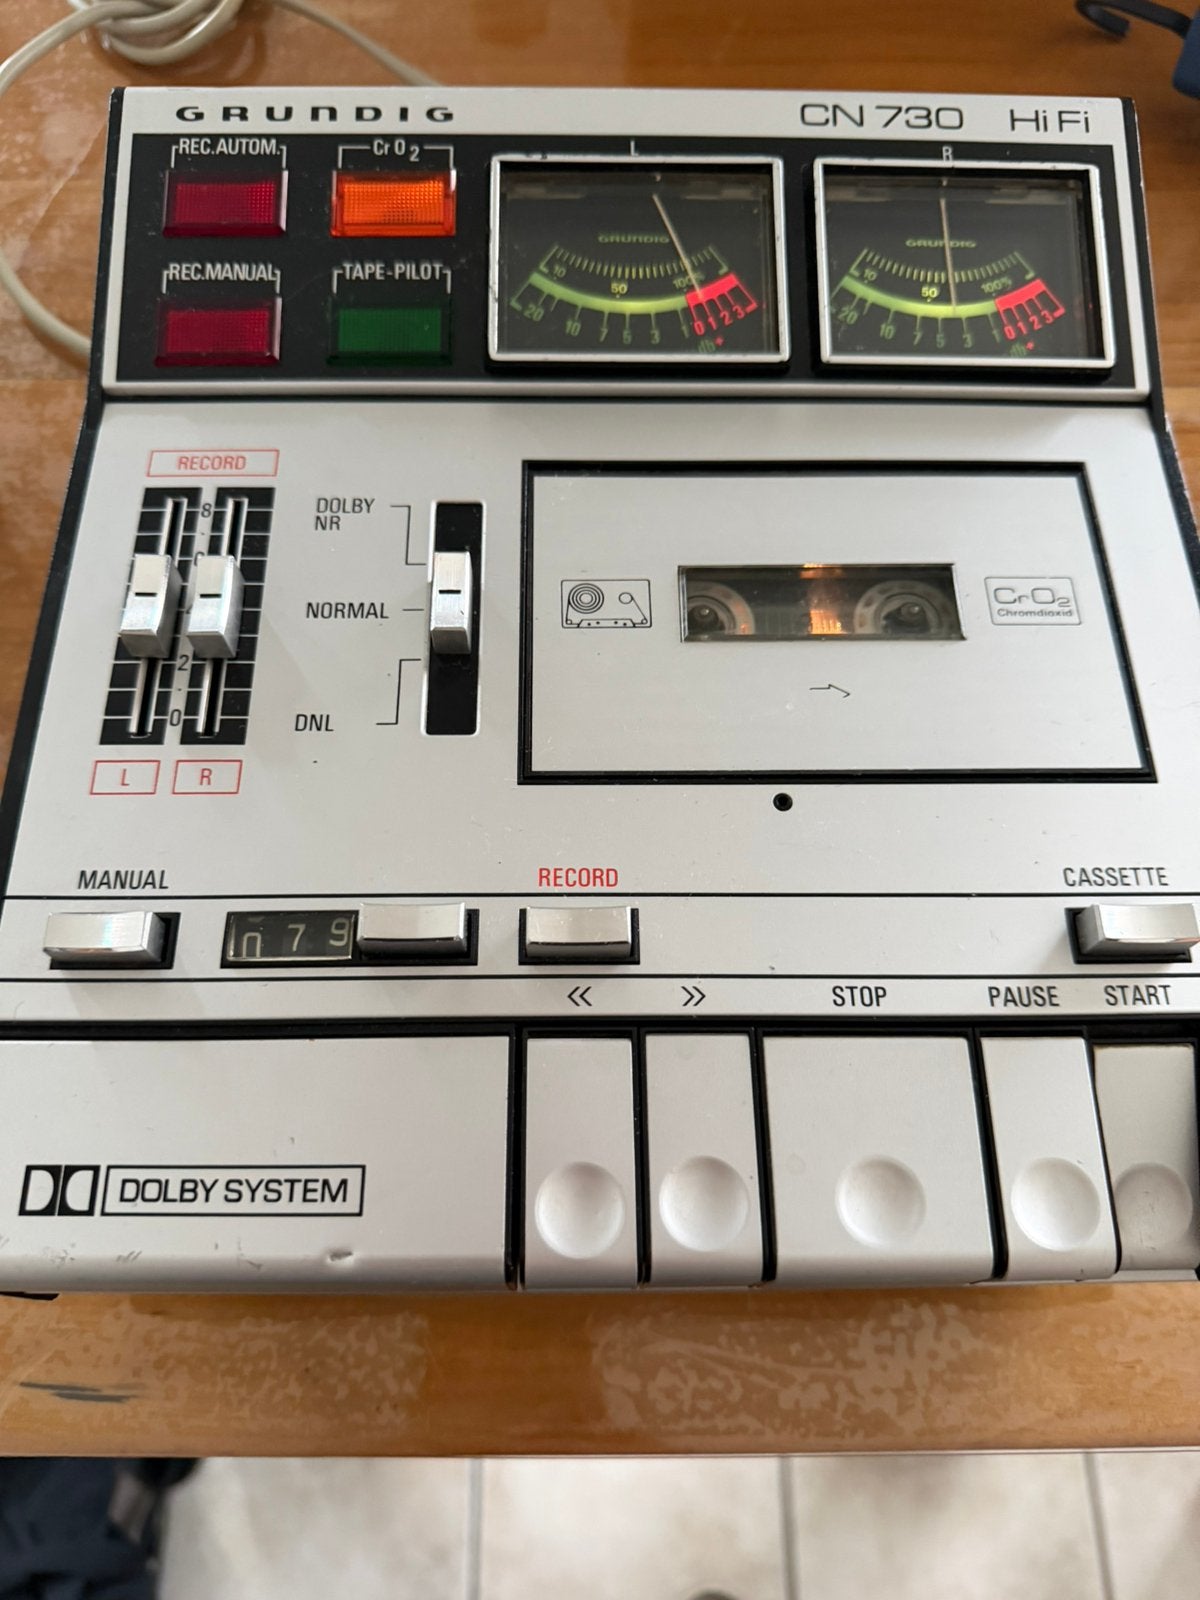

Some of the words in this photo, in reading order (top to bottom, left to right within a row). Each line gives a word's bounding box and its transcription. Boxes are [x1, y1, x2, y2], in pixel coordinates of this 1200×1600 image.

[800, 104, 864, 127] CN
[875, 106, 964, 130] 730
[942, 145, 953, 162] R
[343, 263, 443, 281] TAPE-PILOT
[553, 265, 566, 278] 10
[611, 283, 628, 294] 50
[863, 269, 877, 281] 10
[921, 287, 938, 298] 50
[523, 304, 544, 321] 20
[565, 320, 581, 337] 10
[600, 328, 609, 342] 7
[651, 330, 660, 344] 3
[694, 321, 705, 335] 0
[707, 316, 717, 330] 1
[720, 311, 733, 326] 2
[732, 305, 745, 319] 3
[838, 308, 858, 325] 20
[880, 323, 895, 339] 10
[913, 332, 923, 346] 7
[936, 334, 945, 348] 5
[963, 334, 972, 348] 3
[1004, 325, 1015, 340] 0
[1017, 321, 1027, 335] 1
[1029, 315, 1042, 330] 2
[1041, 310, 1053, 324] 3
[177, 456, 246, 471] RECORD
[200, 503, 213, 518] 8
[316, 498, 375, 513] DOLBY
[314, 516, 341, 531] NR
[306, 602, 389, 619] NORMAL
[997, 608, 1073, 617] Chromdioxid
[177, 654, 190, 671] 2
[169, 709, 182, 726] 0
[295, 714, 334, 732] DNL
[120, 769, 130, 786] L
[199, 768, 212, 785] R
[77, 869, 169, 890] MANUAL
[538, 868, 619, 888] RECORD
[1063, 867, 1169, 887] CASSETTE
[832, 985, 887, 1007] STOP
[988, 986, 1059, 1008] PAUSE
[1105, 985, 1171, 1006] START
[119, 1178, 219, 1203] DOLBY
[223, 1178, 348, 1203] SYSTEM
